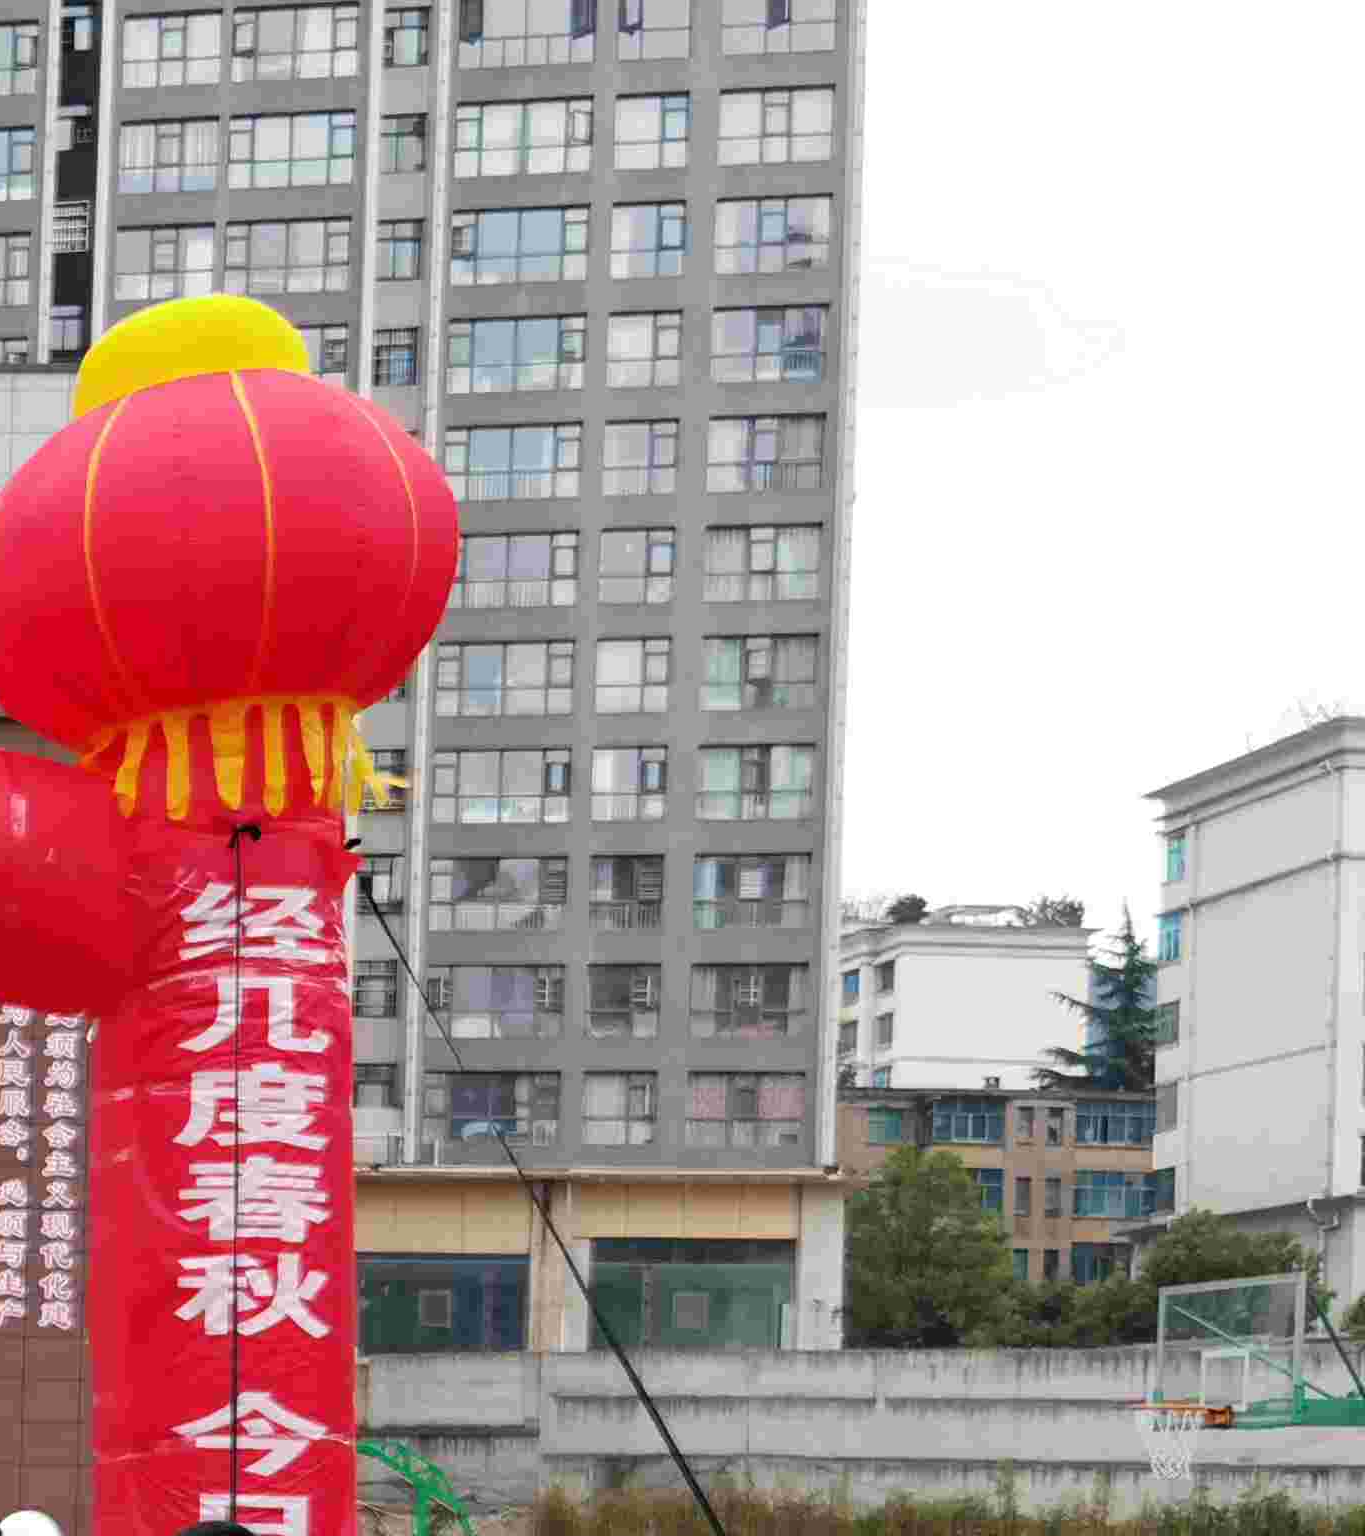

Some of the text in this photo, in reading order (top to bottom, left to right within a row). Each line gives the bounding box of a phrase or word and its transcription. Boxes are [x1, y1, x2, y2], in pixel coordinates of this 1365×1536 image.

[173, 883, 331, 1338] 经几度春秋
